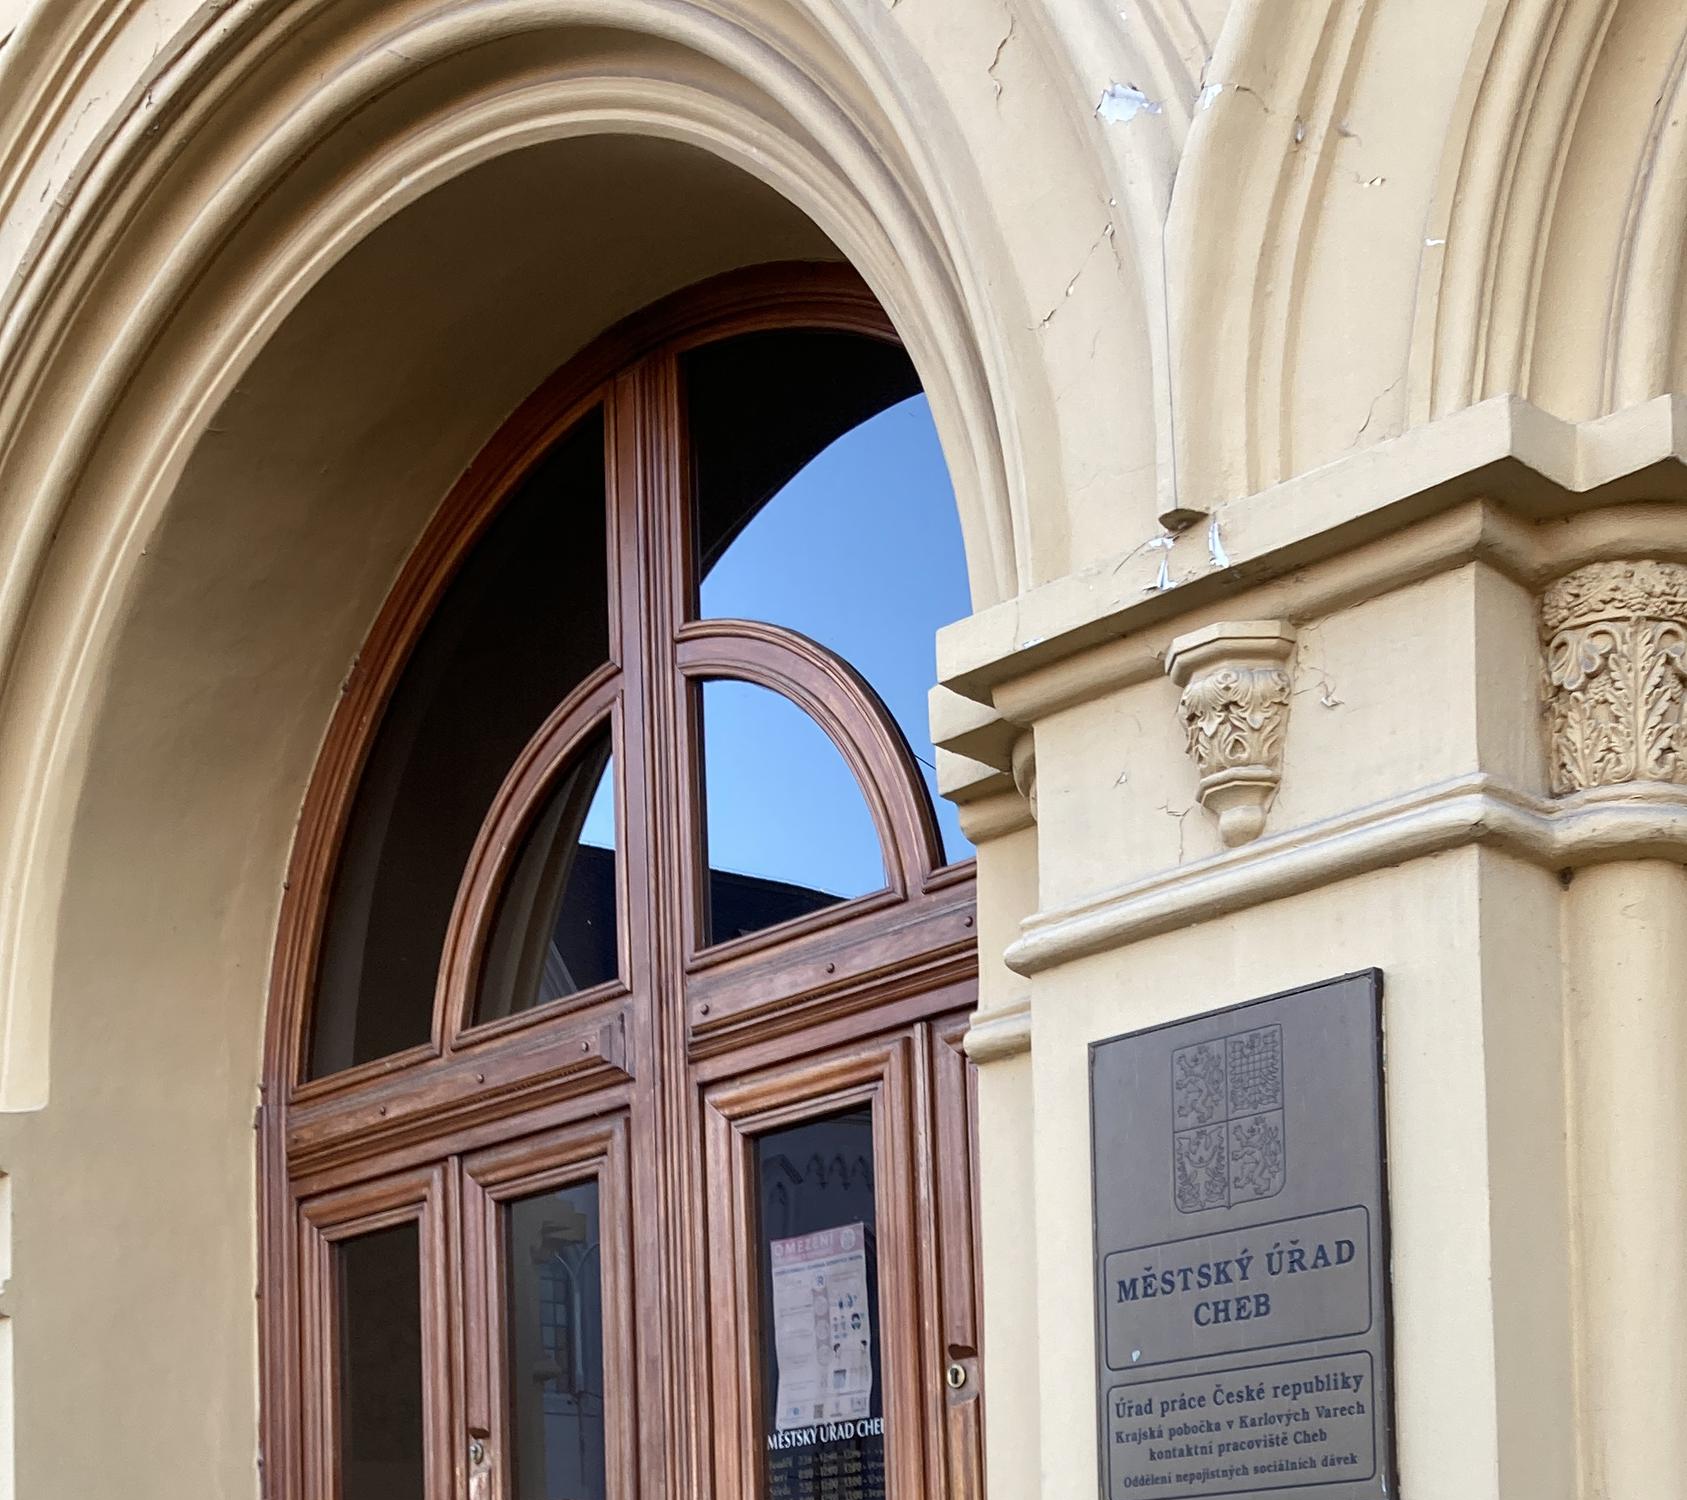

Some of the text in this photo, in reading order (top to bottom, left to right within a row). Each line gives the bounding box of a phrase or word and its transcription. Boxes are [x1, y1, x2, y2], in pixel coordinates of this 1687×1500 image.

[1117, 1239, 1355, 1302] MĚSTSKÝ ÚŘAD
[1194, 1293, 1271, 1327] CHEB
[1115, 1371, 1363, 1418] Úřad práce České republiky
[1115, 1400, 1365, 1445] Krajská pobočka v Karlových Varech
[1149, 1428, 1328, 1461] kontaktní pracoviště Cheb
[1123, 1453, 1358, 1488] Oddělení nepojistných sociálních dávek
